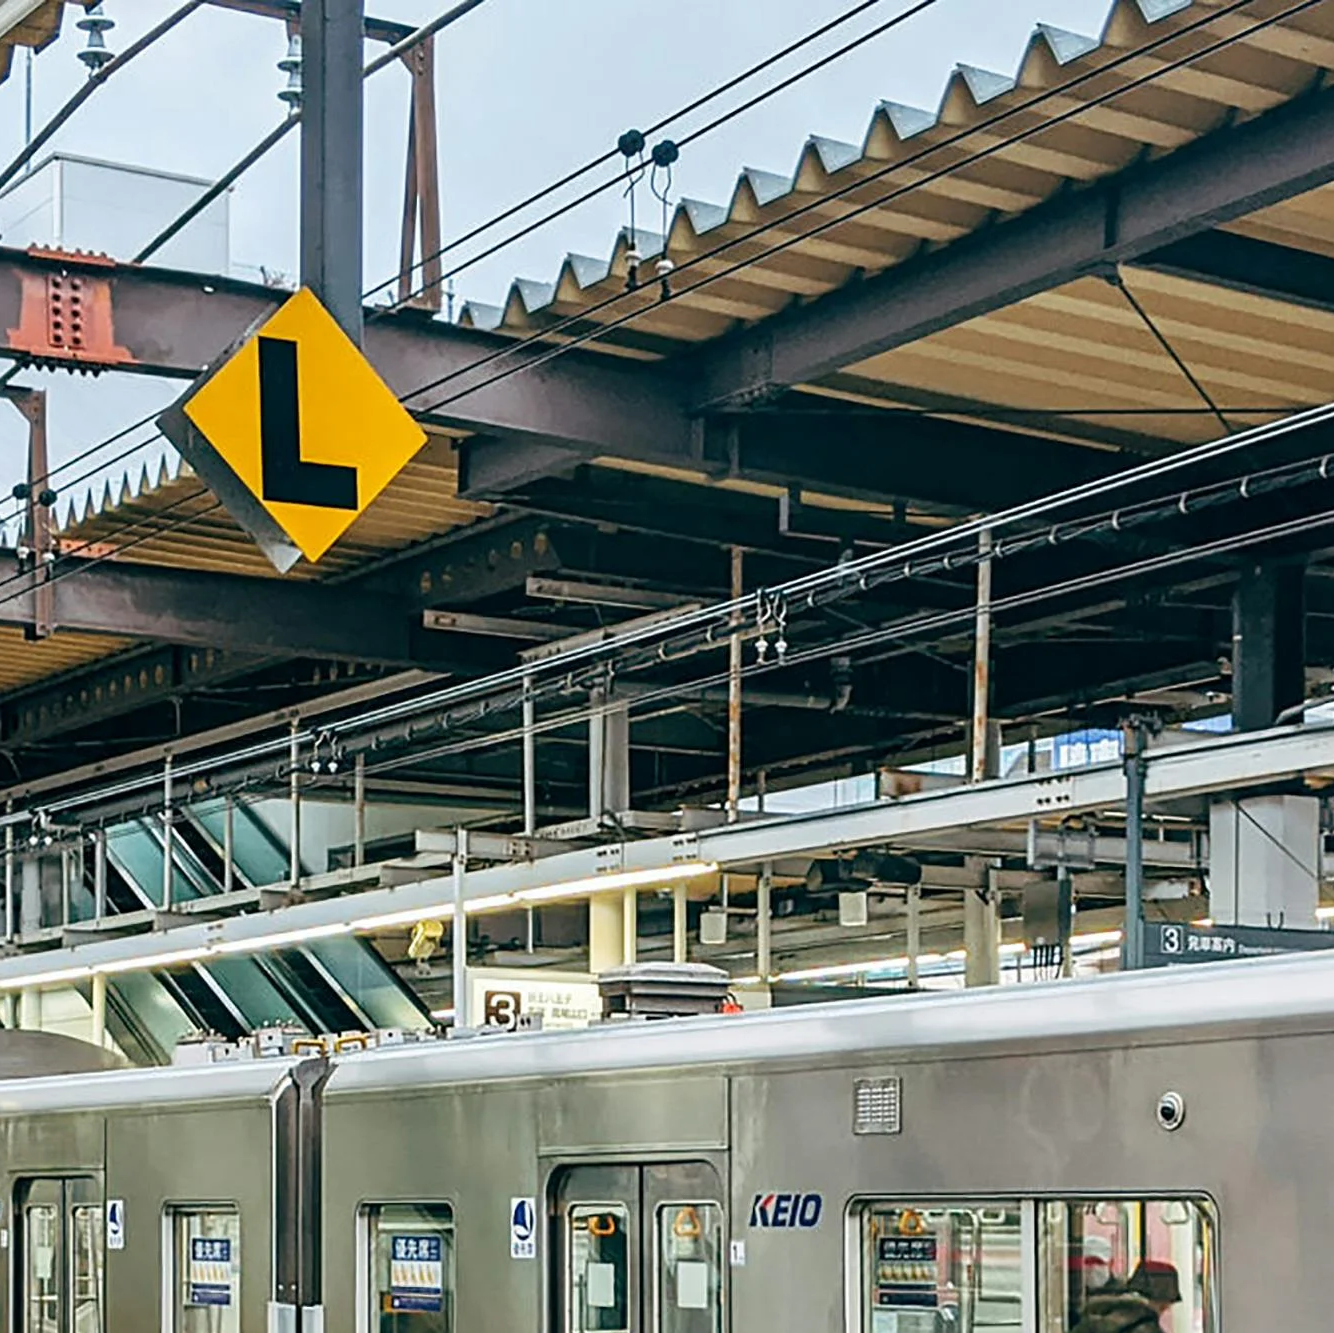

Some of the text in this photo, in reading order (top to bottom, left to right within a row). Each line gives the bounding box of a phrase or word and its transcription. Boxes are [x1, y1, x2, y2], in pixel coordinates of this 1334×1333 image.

[258, 336, 358, 511] L
[1165, 928, 1178, 952] 3
[490, 994, 515, 1029] 3
[749, 1193, 822, 1227] KEIO
